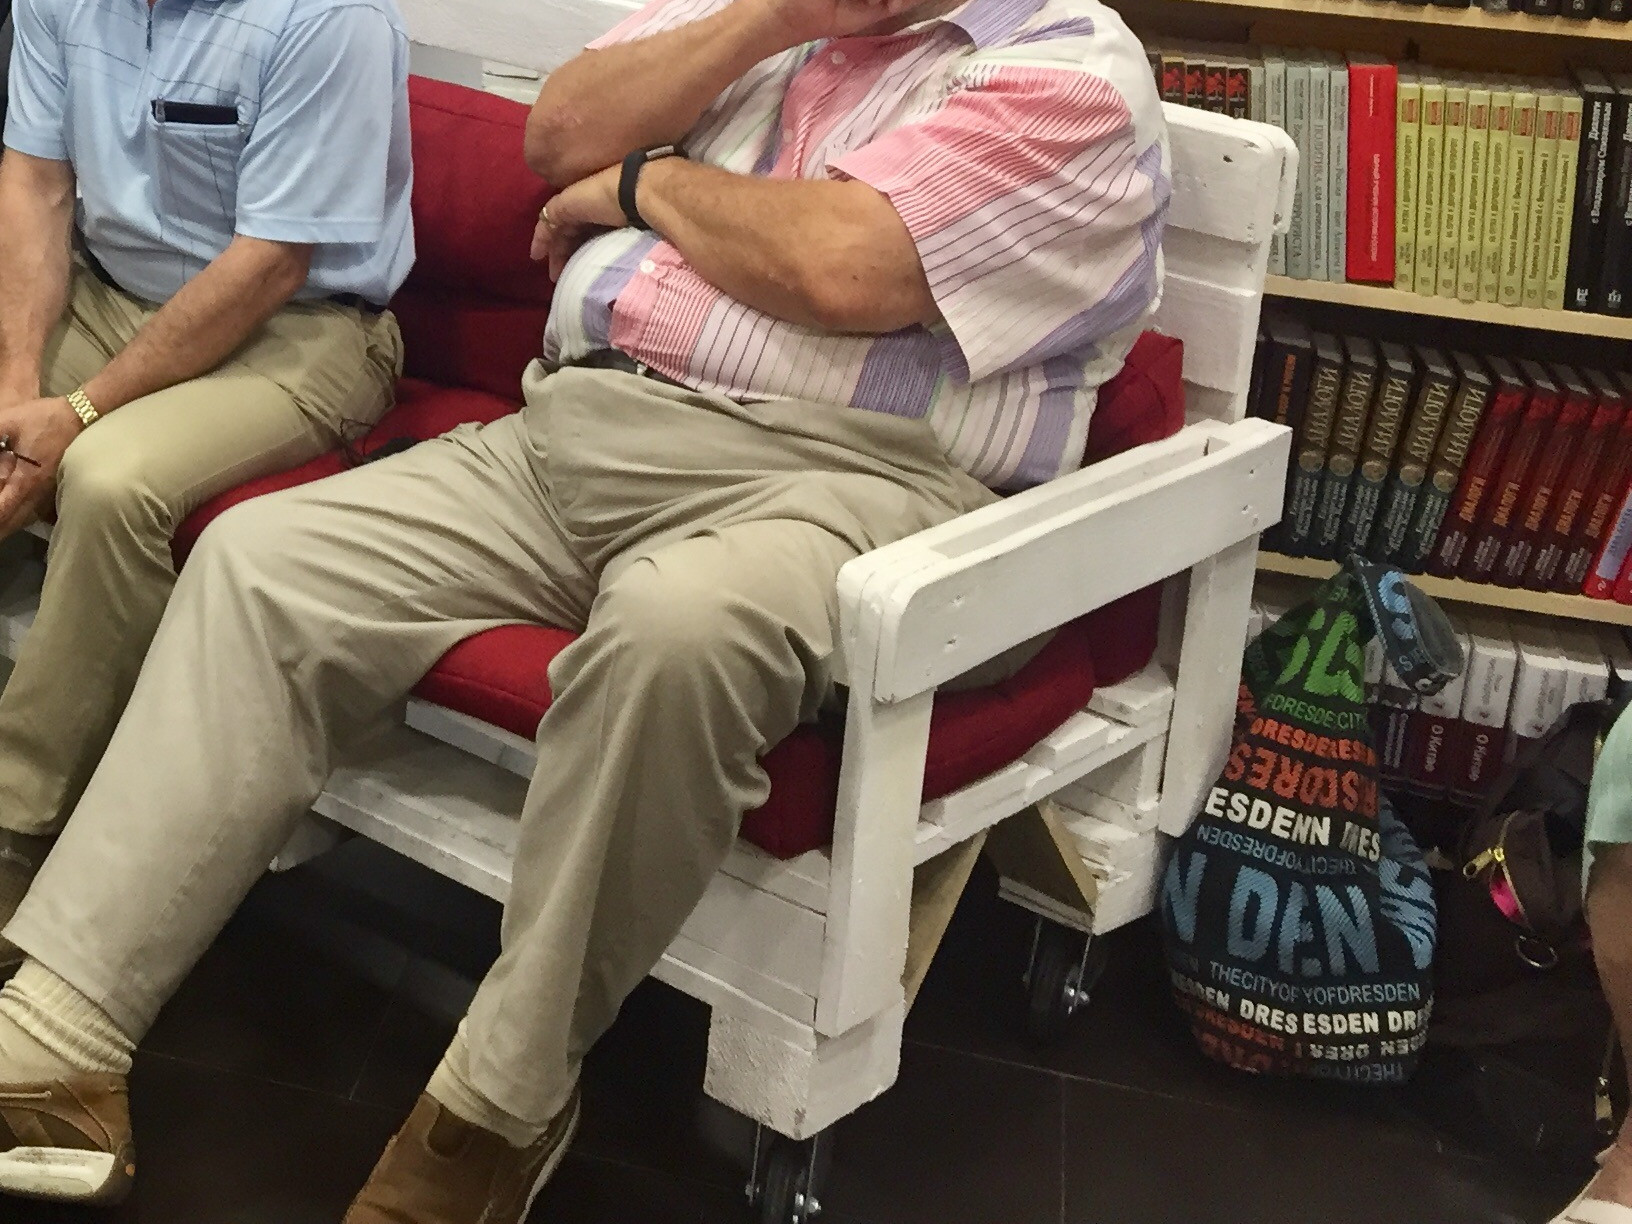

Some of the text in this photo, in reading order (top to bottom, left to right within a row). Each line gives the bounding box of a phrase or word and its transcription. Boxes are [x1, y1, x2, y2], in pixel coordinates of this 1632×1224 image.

[1307, 366, 1339, 448] ДИАЛОГИ
[1337, 371, 1371, 452] ДИАЛОГИ
[1371, 377, 1408, 458] ДИАЛОГИ
[1410, 381, 1450, 462] ДИАЛОГИ
[1444, 386, 1487, 467] ДИАЛОГИ
